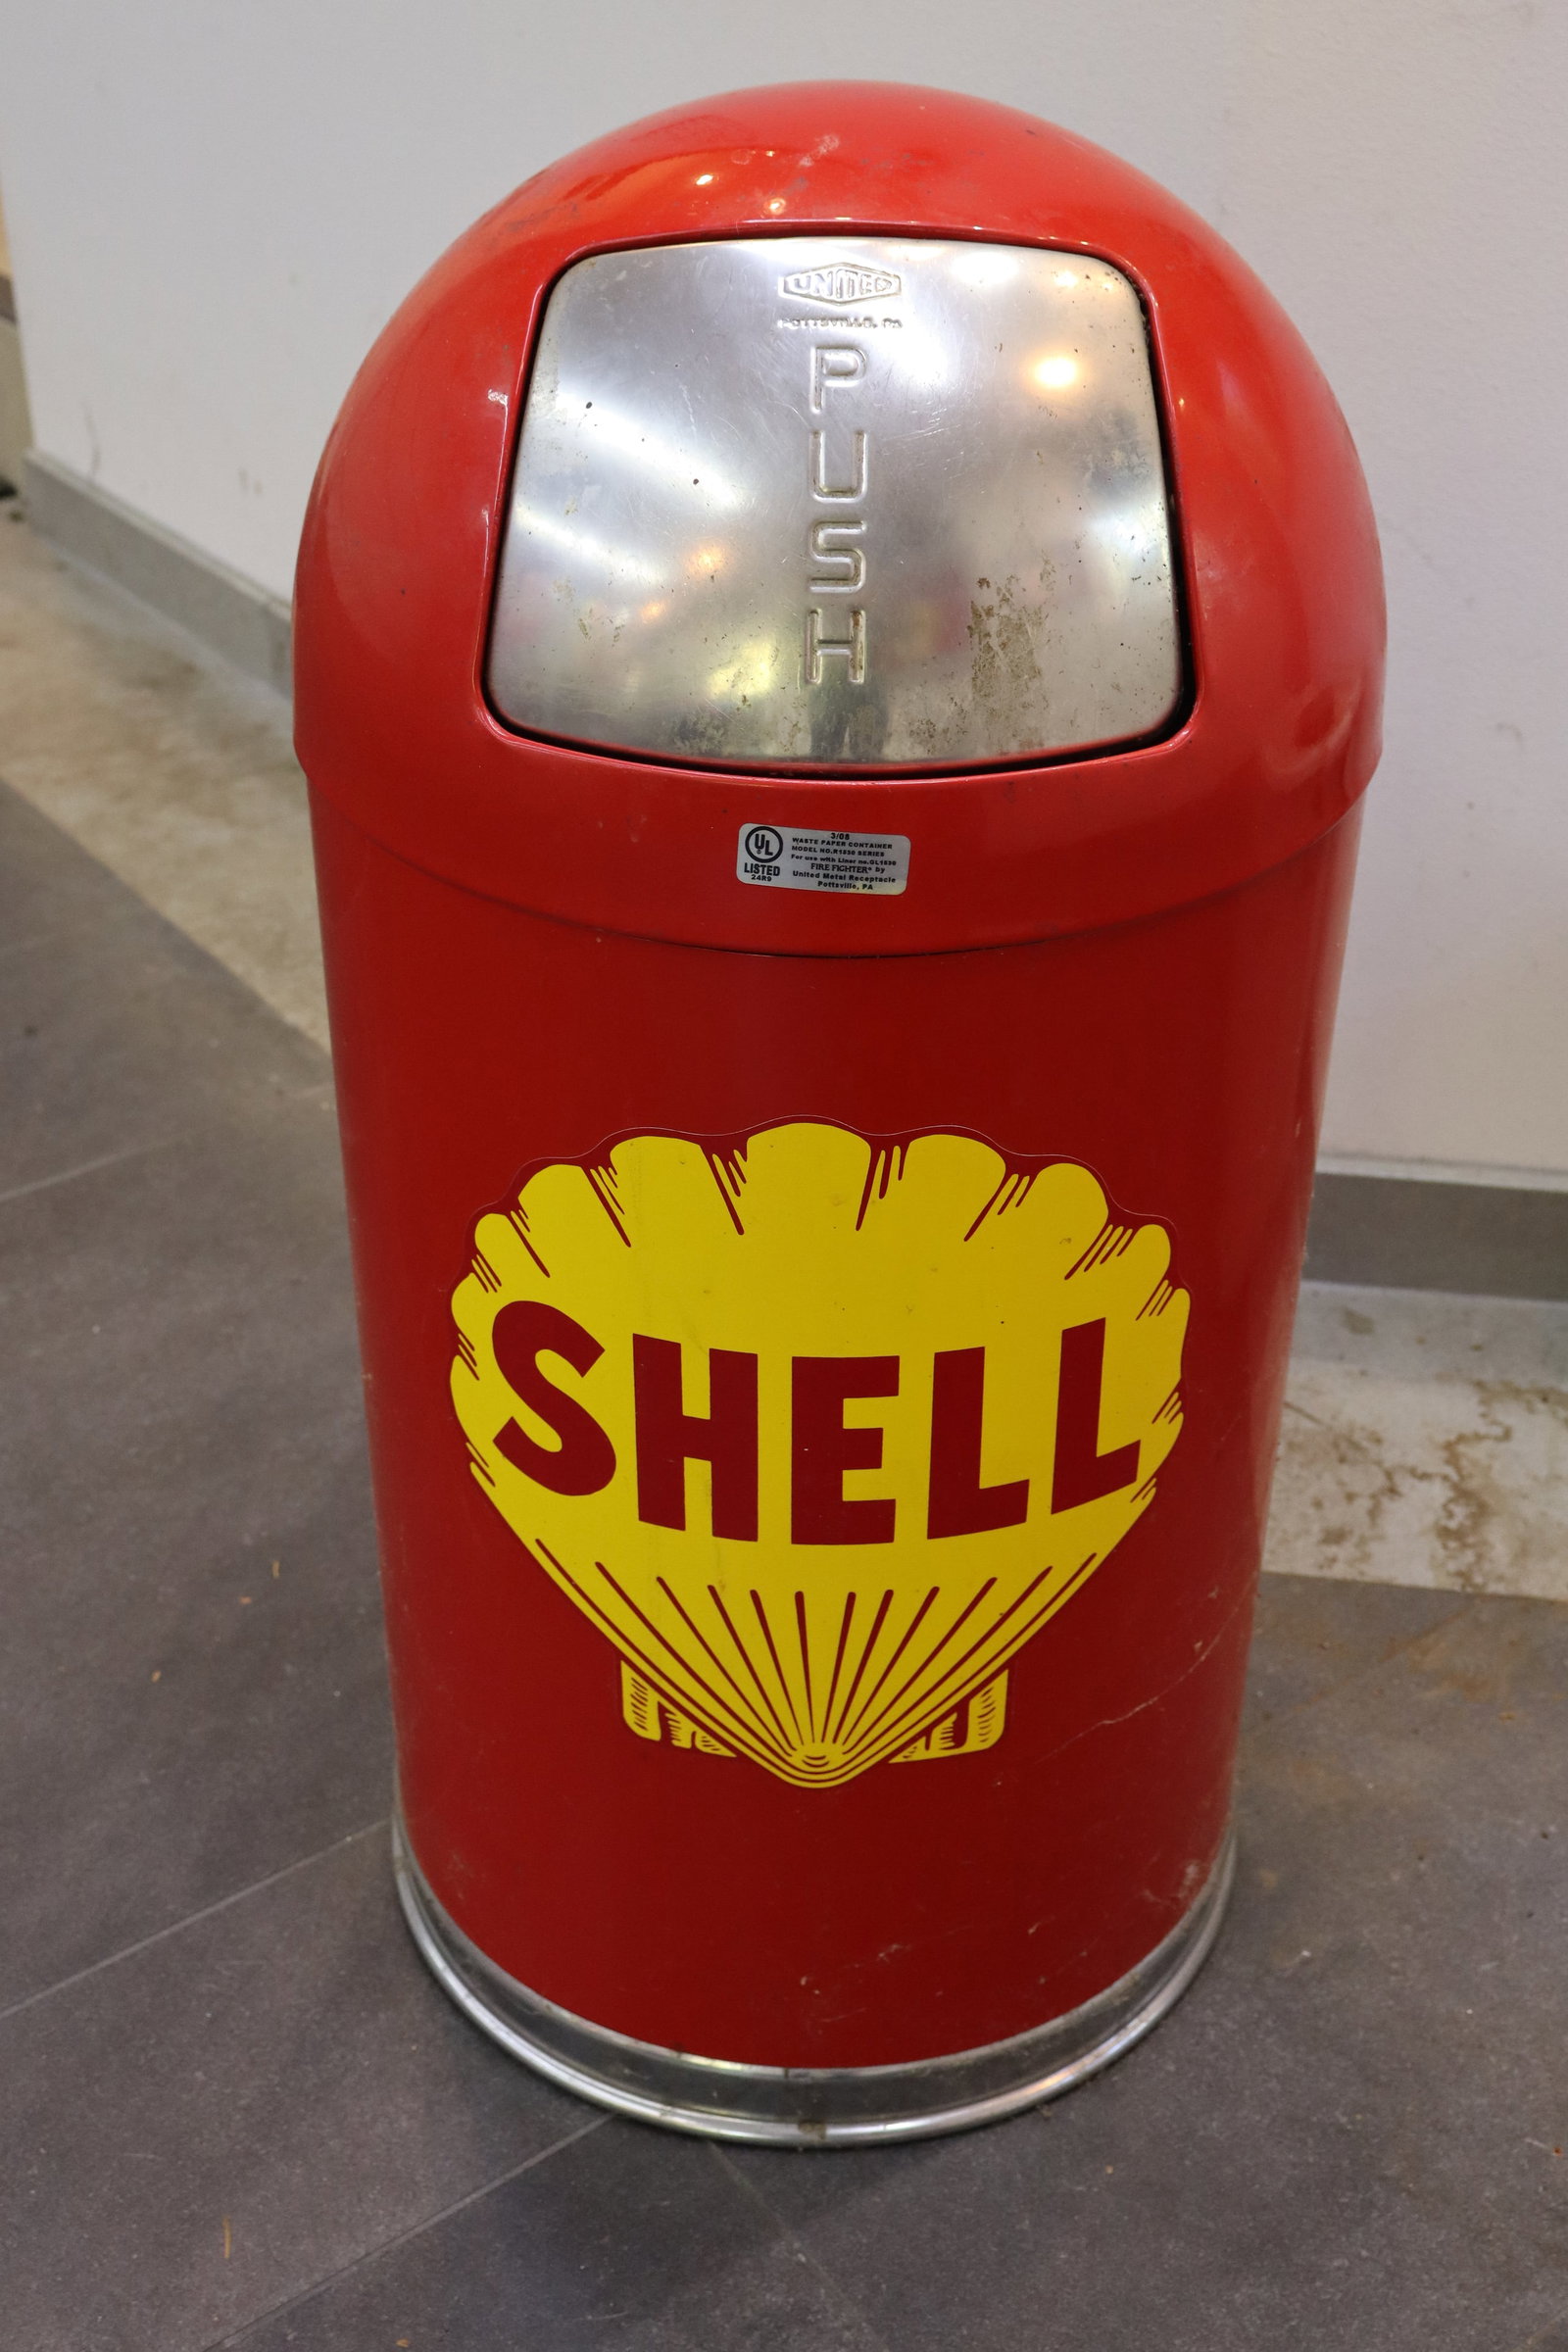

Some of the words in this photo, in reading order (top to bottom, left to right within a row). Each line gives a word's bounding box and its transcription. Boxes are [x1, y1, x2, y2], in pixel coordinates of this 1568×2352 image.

[787, 267, 894, 299] UNITED
[805, 346, 868, 685] PUSH
[755, 833, 774, 856] UL
[744, 862, 780, 876] LISTED
[810, 862, 830, 871] FIRE
[817, 880, 859, 890] Pottsville,
[849, 874, 896, 883] Receptacle
[492, 1300, 1141, 1545] SHELL
